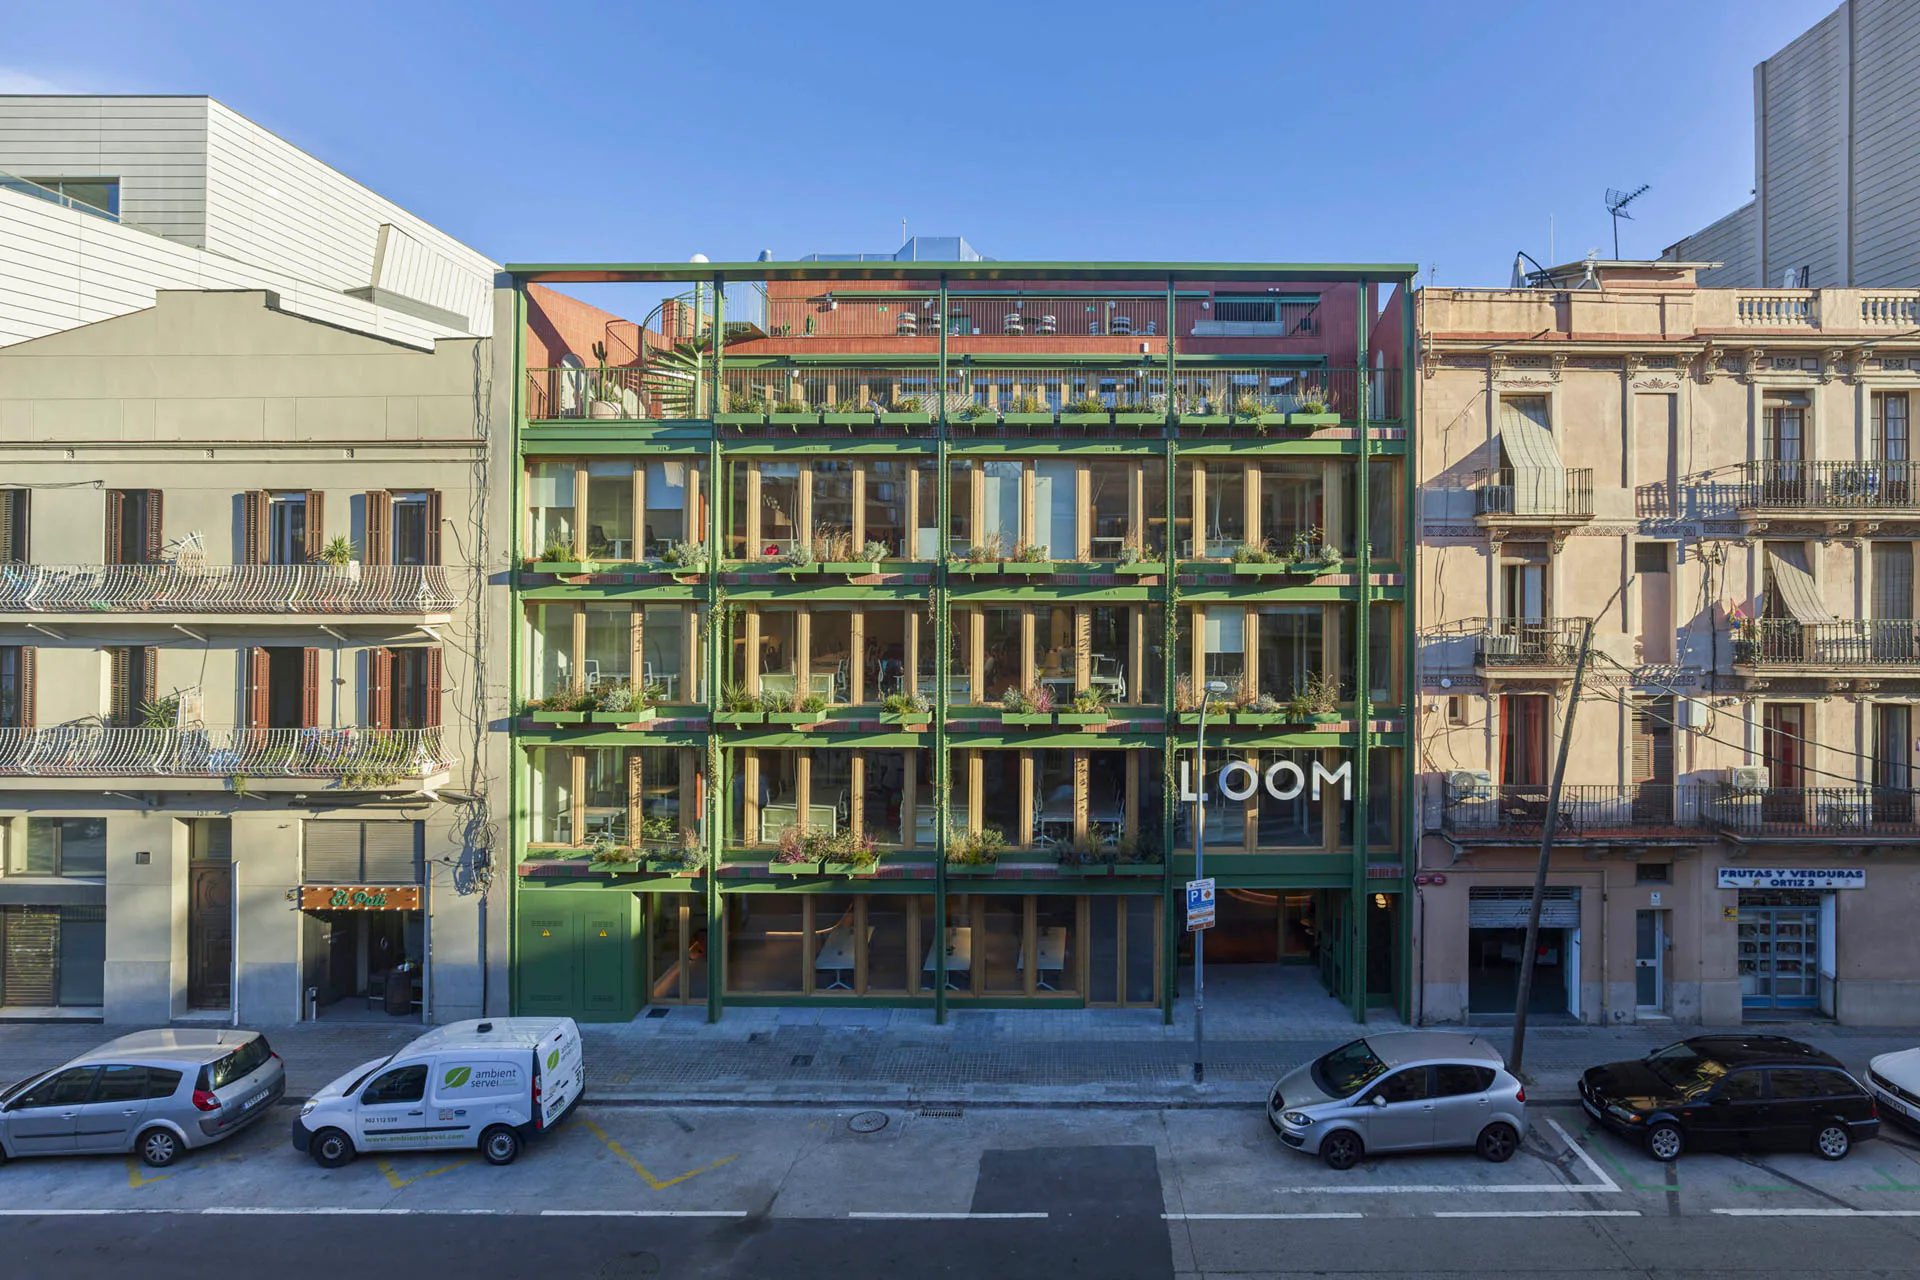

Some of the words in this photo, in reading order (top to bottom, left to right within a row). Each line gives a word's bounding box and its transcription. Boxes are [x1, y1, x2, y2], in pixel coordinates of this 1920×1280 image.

[1181, 760, 1352, 801] LOOM
[1720, 870, 1772, 878] FRUTAS
[1776, 870, 1786, 878] Y
[1790, 870, 1864, 878] VERDURAS
[330, 889, 349, 906] El
[353, 890, 388, 906] Pati
[1191, 890, 1199, 902] P
[475, 1068, 517, 1079] ambient
[471, 1079, 499, 1088] servei
